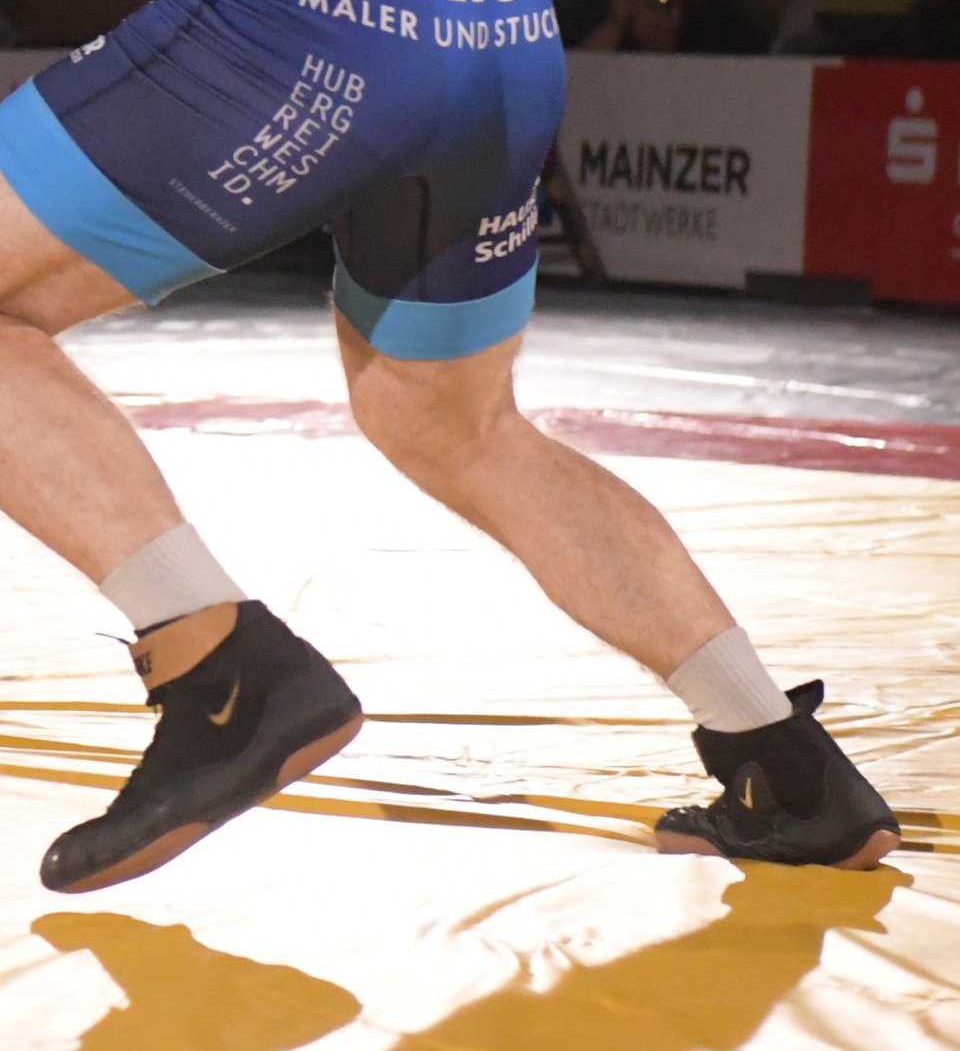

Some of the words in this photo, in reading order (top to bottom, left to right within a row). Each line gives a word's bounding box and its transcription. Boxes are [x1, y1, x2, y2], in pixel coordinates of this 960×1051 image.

[434, 17, 489, 50] UND
[301, 54, 366, 103] HUB
[272, 103, 340, 157] REI
[290, 81, 354, 134] ERG
[233, 145, 298, 194] CHM
[253, 124, 319, 176] WES
[579, 139, 751, 195] MAINZER
[588, 200, 719, 242] TADTWERKE
